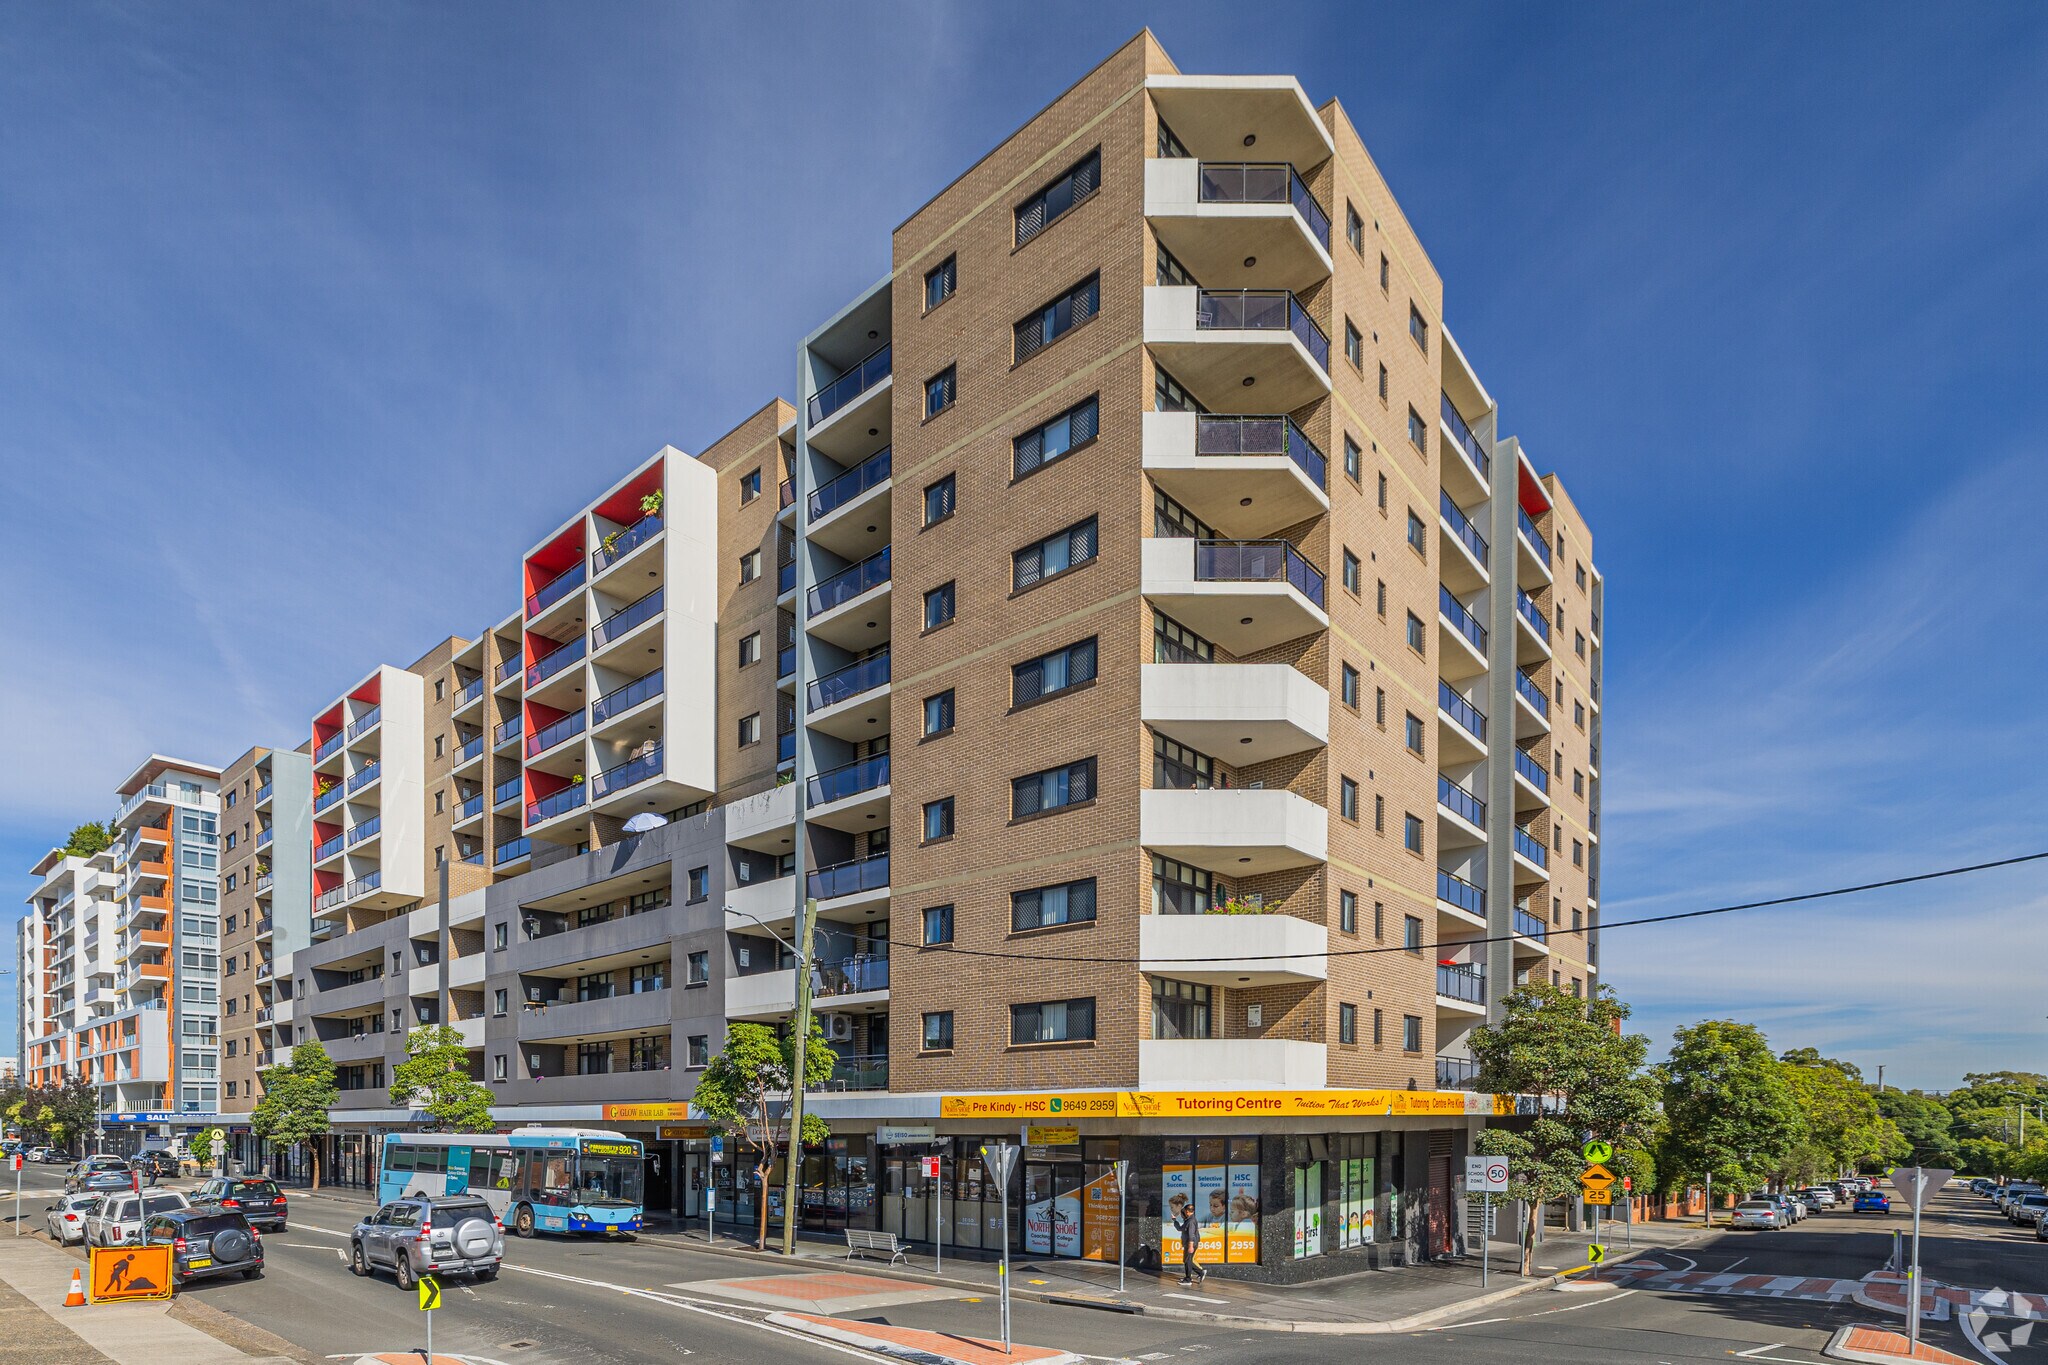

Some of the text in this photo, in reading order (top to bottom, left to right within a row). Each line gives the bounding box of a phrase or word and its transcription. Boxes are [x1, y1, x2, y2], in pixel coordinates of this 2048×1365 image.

[973, 1103, 988, 1112] Pre
[990, 1102, 1017, 1114] Kindy
[1024, 1101, 1046, 1111] HSC
[1063, 1100, 1115, 1111] 9649 2959
[1123, 1102, 1161, 1112] NORTH SHORE
[1176, 1097, 1282, 1112] Tutoring Centre
[1294, 1097, 1325, 1109] Tuition
[1328, 1099, 1350, 1109] That
[1351, 1096, 1385, 1108] Works!
[1410, 1097, 1429, 1111] Tutoring
[1432, 1098, 1447, 1109] Centre
[1447, 1098, 1455, 1109] Pre
[620, 1108, 638, 1117] GLOW
[638, 1109, 652, 1117] HAIR
[653, 1109, 665, 1117] LAB
[944, 1104, 971, 1113] NORTH SHORE
[618, 1145, 632, 1155] 920
[1171, 1174, 1183, 1182] OC
[1234, 1173, 1251, 1181] HSC
[1491, 1170, 1505, 1179] 50
[1589, 1190, 1606, 1199] 25
[1027, 1218, 1078, 1236] NORTH SHORE
[1197, 1241, 1222, 1250] 9649
[1230, 1240, 1255, 1250] 2959
